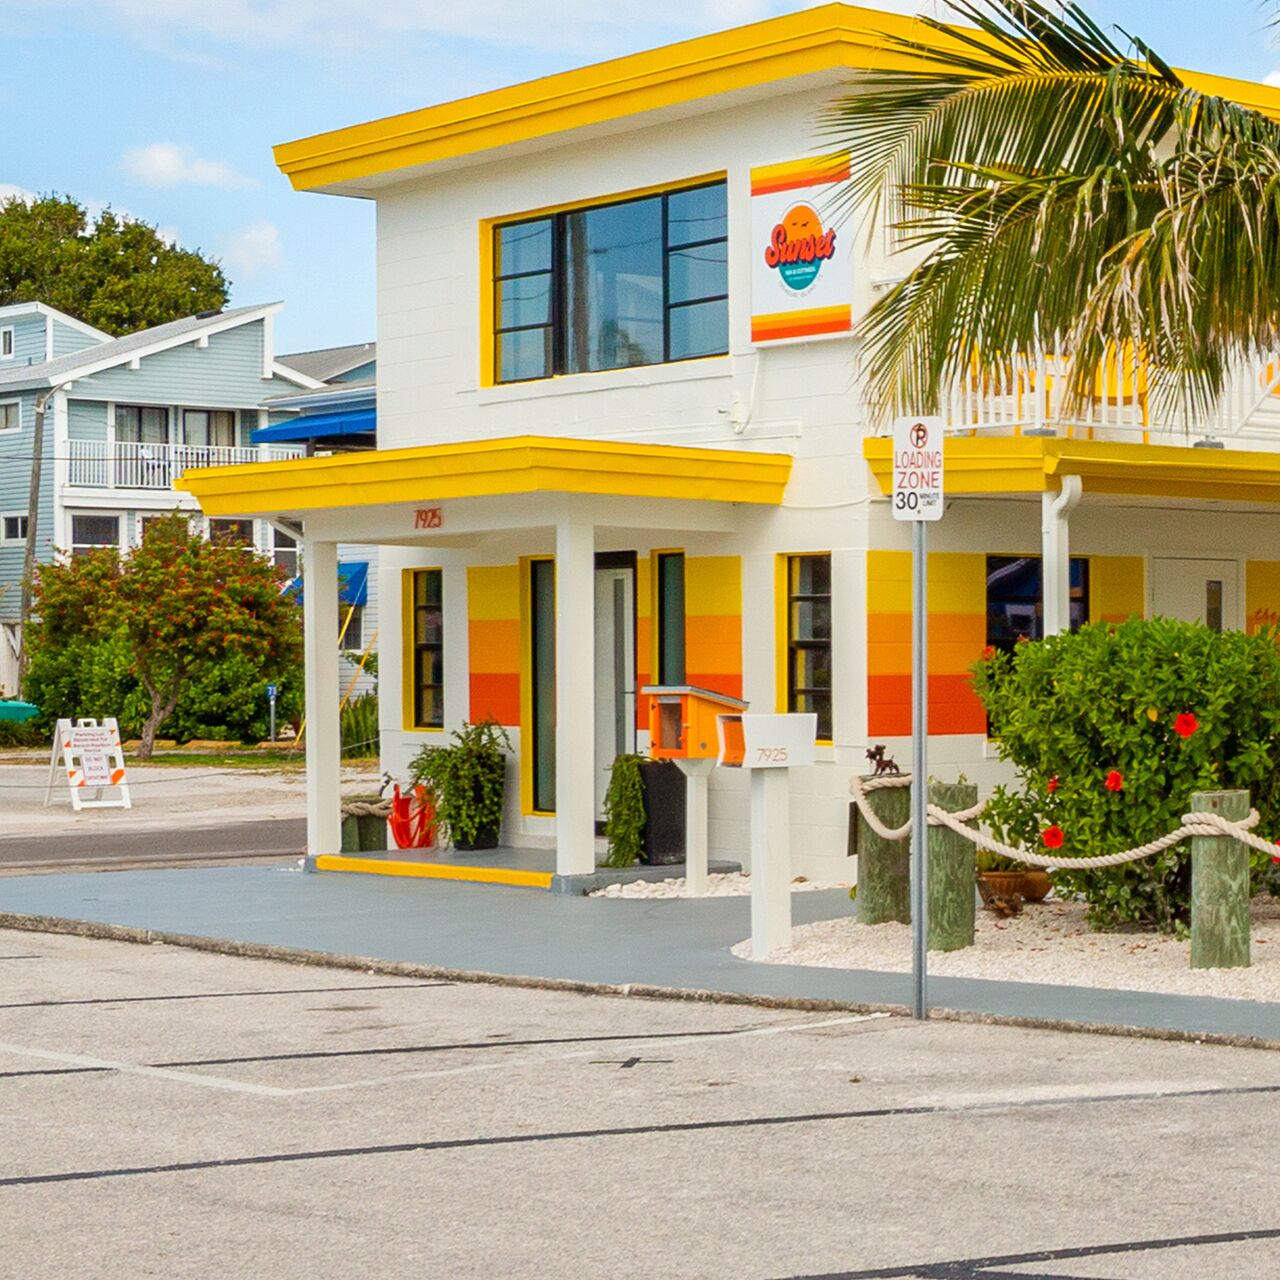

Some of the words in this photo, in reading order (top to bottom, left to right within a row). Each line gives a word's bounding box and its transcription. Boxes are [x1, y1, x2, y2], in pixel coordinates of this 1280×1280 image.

[765, 223, 836, 268] Sunset
[895, 451, 942, 468] LOADING
[897, 471, 940, 489] ZONE
[895, 491, 918, 510] 30
[413, 508, 443, 528] 7925
[756, 747, 788, 762] 7925
